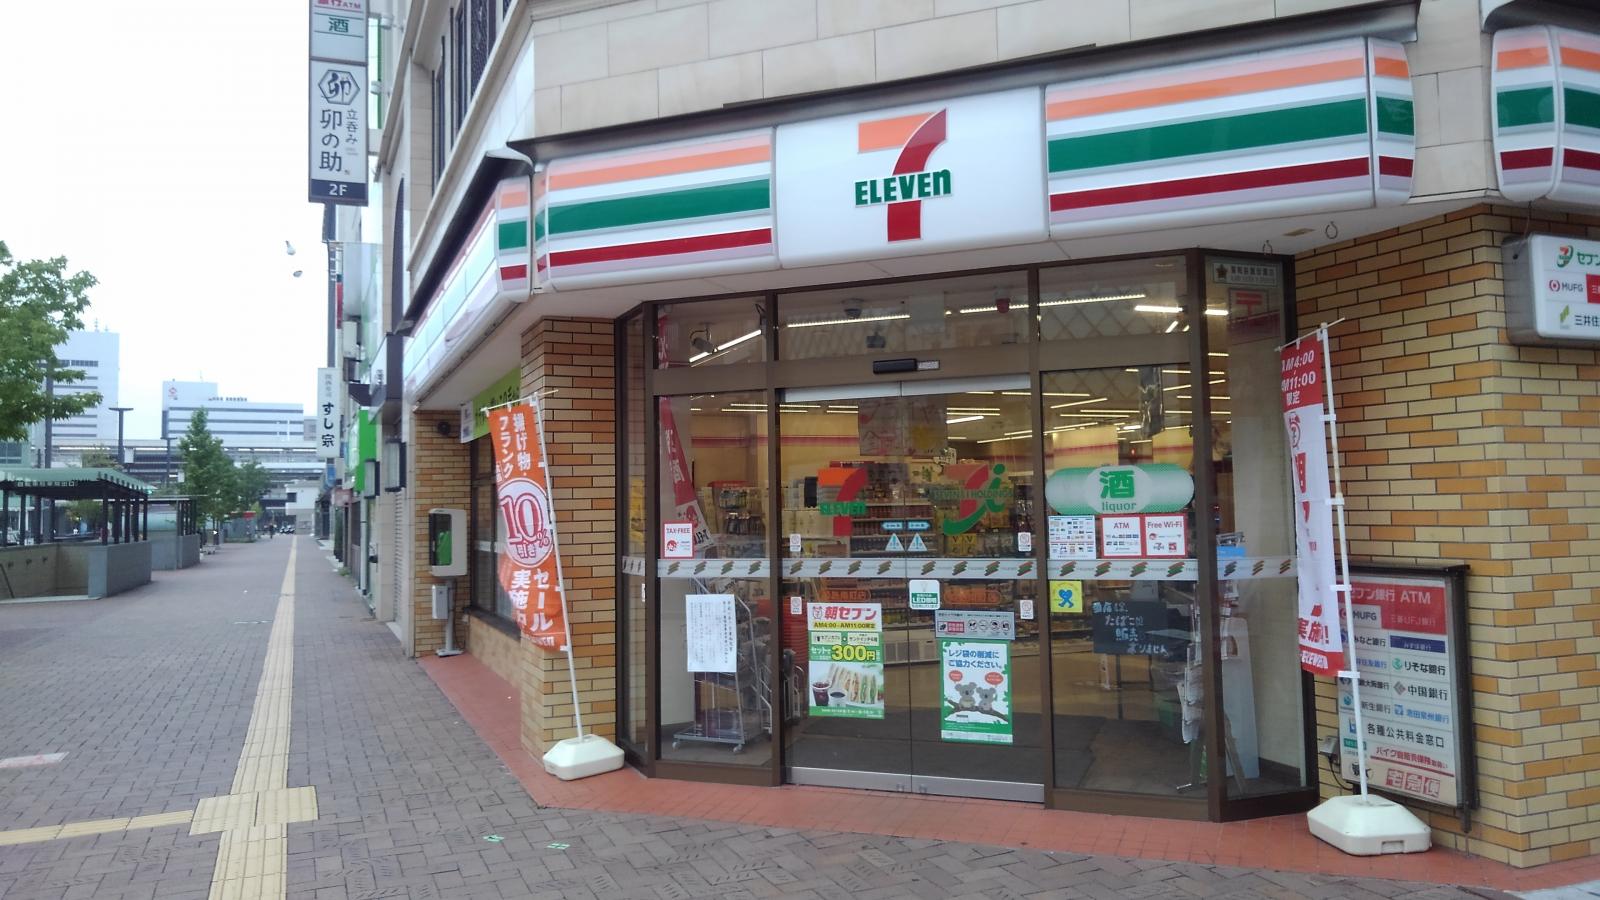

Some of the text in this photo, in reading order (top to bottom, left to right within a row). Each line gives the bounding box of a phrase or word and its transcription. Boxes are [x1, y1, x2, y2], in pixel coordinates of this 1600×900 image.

[328, 17, 349, 33] 酒
[319, 109, 342, 172] 卯の助
[329, 184, 348, 196] 2F
[1561, 281, 1584, 293] MUFG
[322, 402, 335, 448] すし宗
[499, 416, 513, 480] フランク
[1099, 470, 1135, 499] 酒
[1102, 501, 1137, 512] liquor
[500, 492, 551, 547] 10%
[1147, 521, 1163, 529] Free
[516, 543, 537, 558] 引き
[531, 569, 554, 632] セール
[1401, 591, 1431, 604] ATM
[824, 606, 877, 621] 朝セブン
[1353, 610, 1377, 621] MUFG
[831, 644, 876, 661] 300円
[948, 650, 1000, 659] レジ袋の削減に
[1404, 659, 1447, 676] りそな銀行
[1407, 684, 1448, 701] 中国銀行
[1367, 723, 1445, 748] 各種公共料金窓口
[1386, 768, 1441, 797] 宅急便
